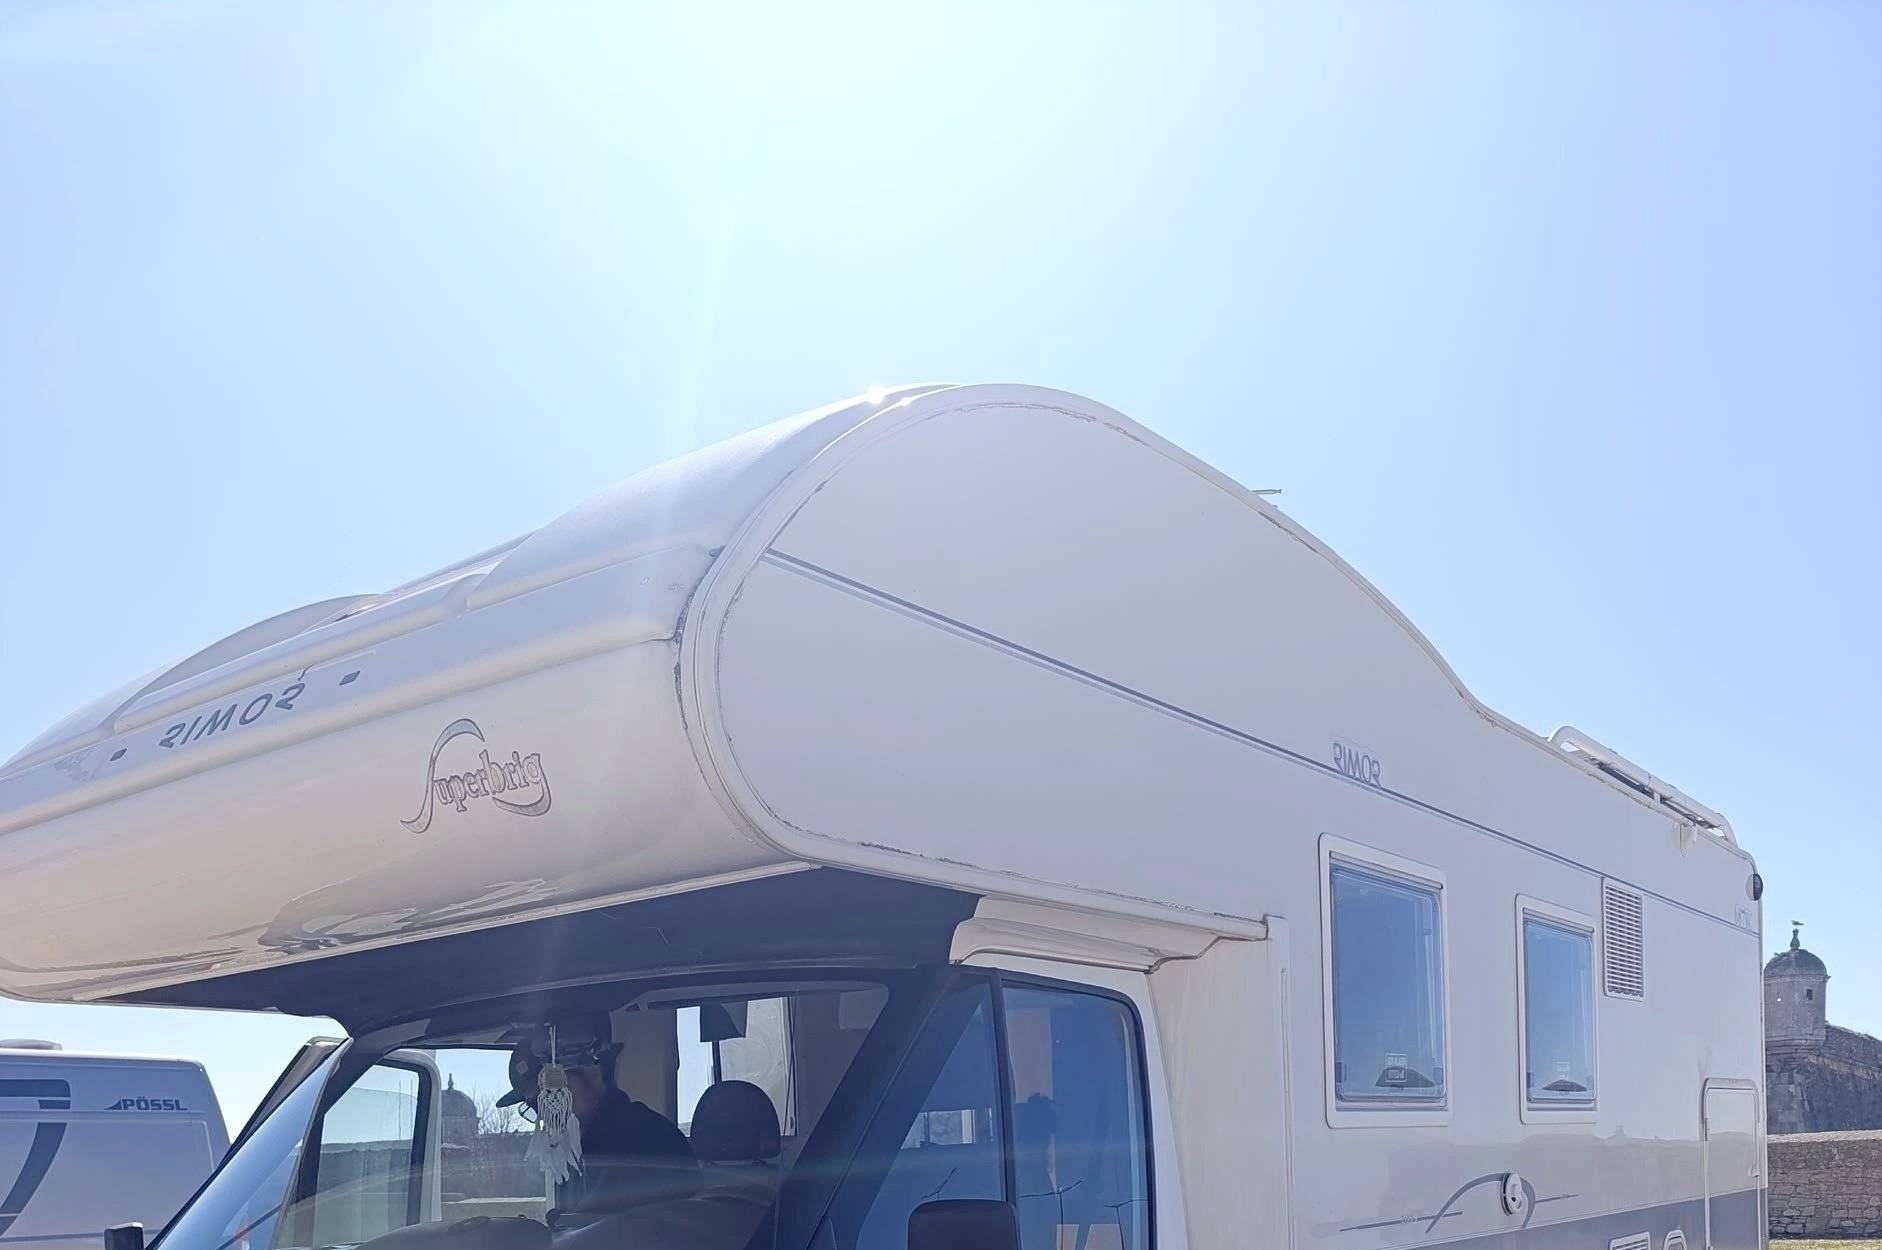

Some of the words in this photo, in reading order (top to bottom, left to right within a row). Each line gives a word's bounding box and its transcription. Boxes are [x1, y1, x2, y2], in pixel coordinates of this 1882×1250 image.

[400, 718, 551, 833] Superbrig
[1333, 742, 1381, 787] RIMOR
[121, 1096, 188, 1111] PÖSSL
